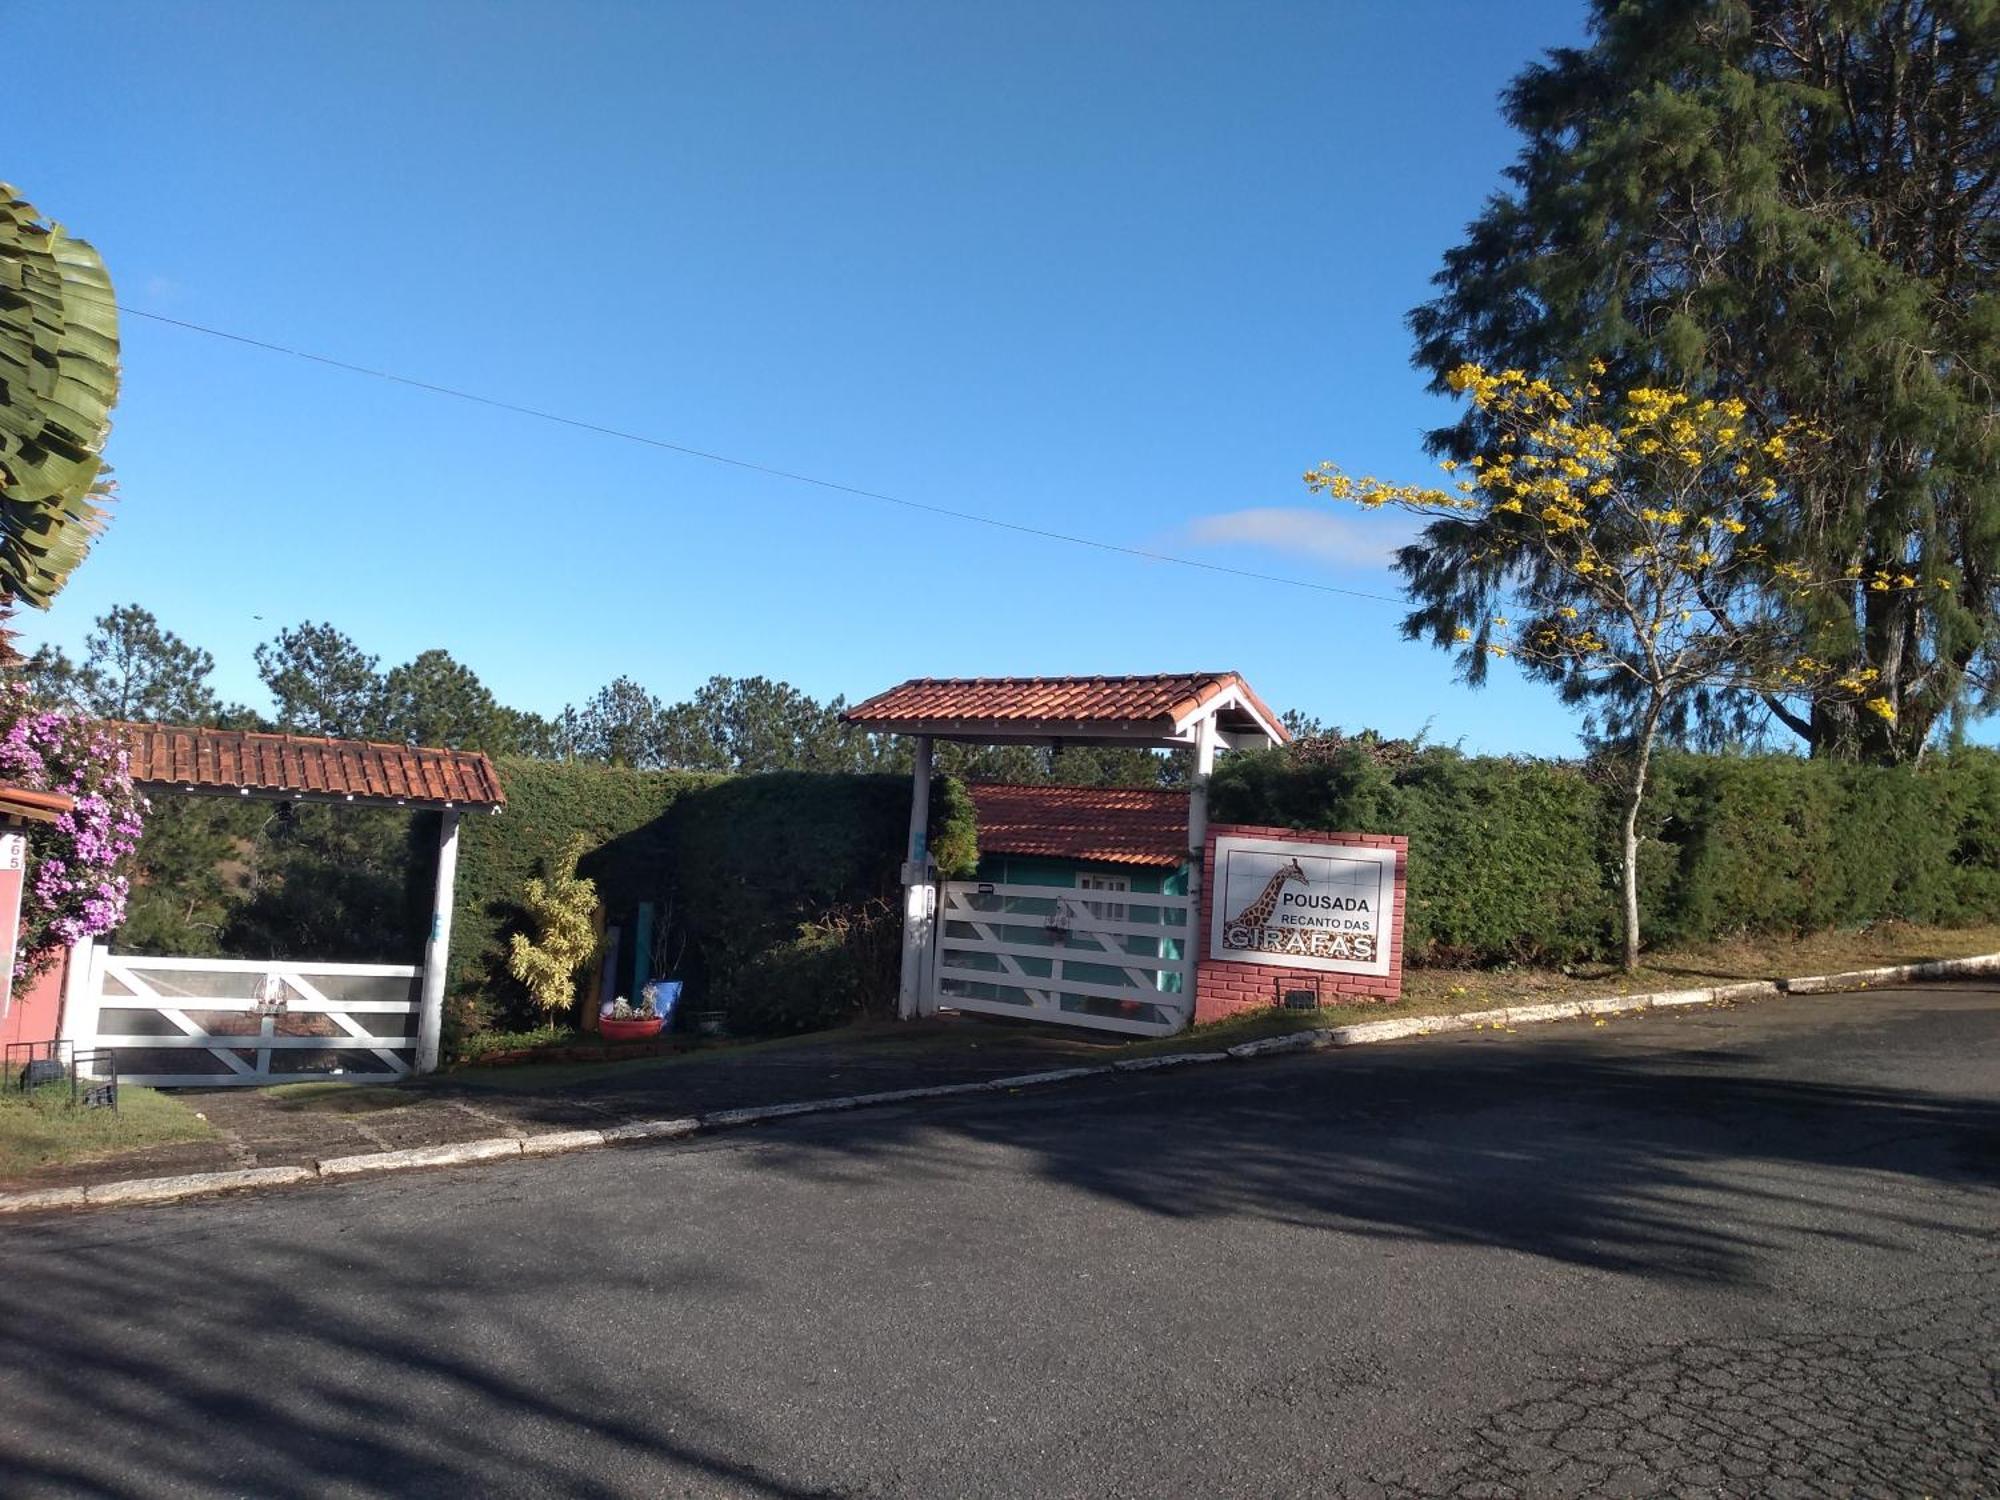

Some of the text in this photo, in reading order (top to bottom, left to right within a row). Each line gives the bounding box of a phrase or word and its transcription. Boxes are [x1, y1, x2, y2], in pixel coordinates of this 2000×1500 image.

[1283, 893, 1370, 912] POUSADA
[1282, 914, 1370, 931] RECANTO DAS
[1227, 926, 1372, 957] GIRAFAS
